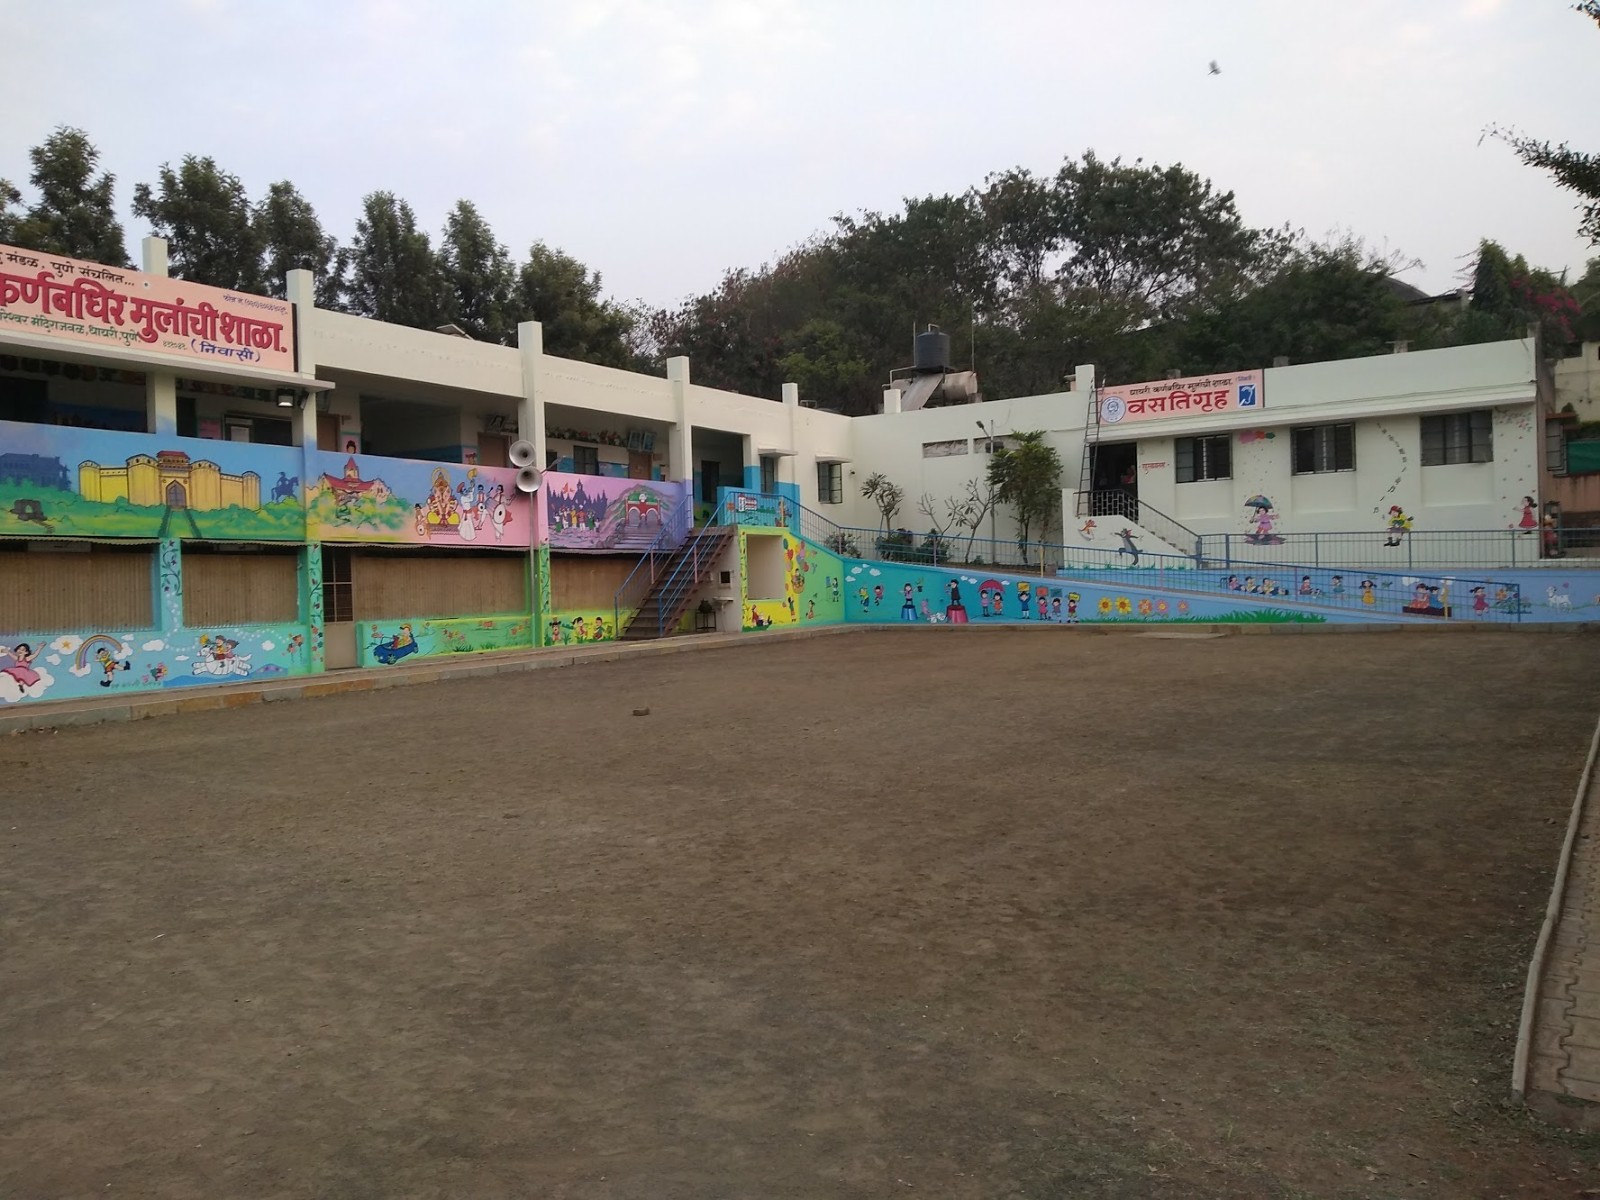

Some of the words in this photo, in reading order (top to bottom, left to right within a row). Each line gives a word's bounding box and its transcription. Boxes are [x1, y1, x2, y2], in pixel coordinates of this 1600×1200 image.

[50, 261, 75, 278] पुणे
[130, 297, 219, 343] मुलांची
[219, 312, 287, 353] शाळा.
[1127, 389, 1230, 412] वसतिगृह
